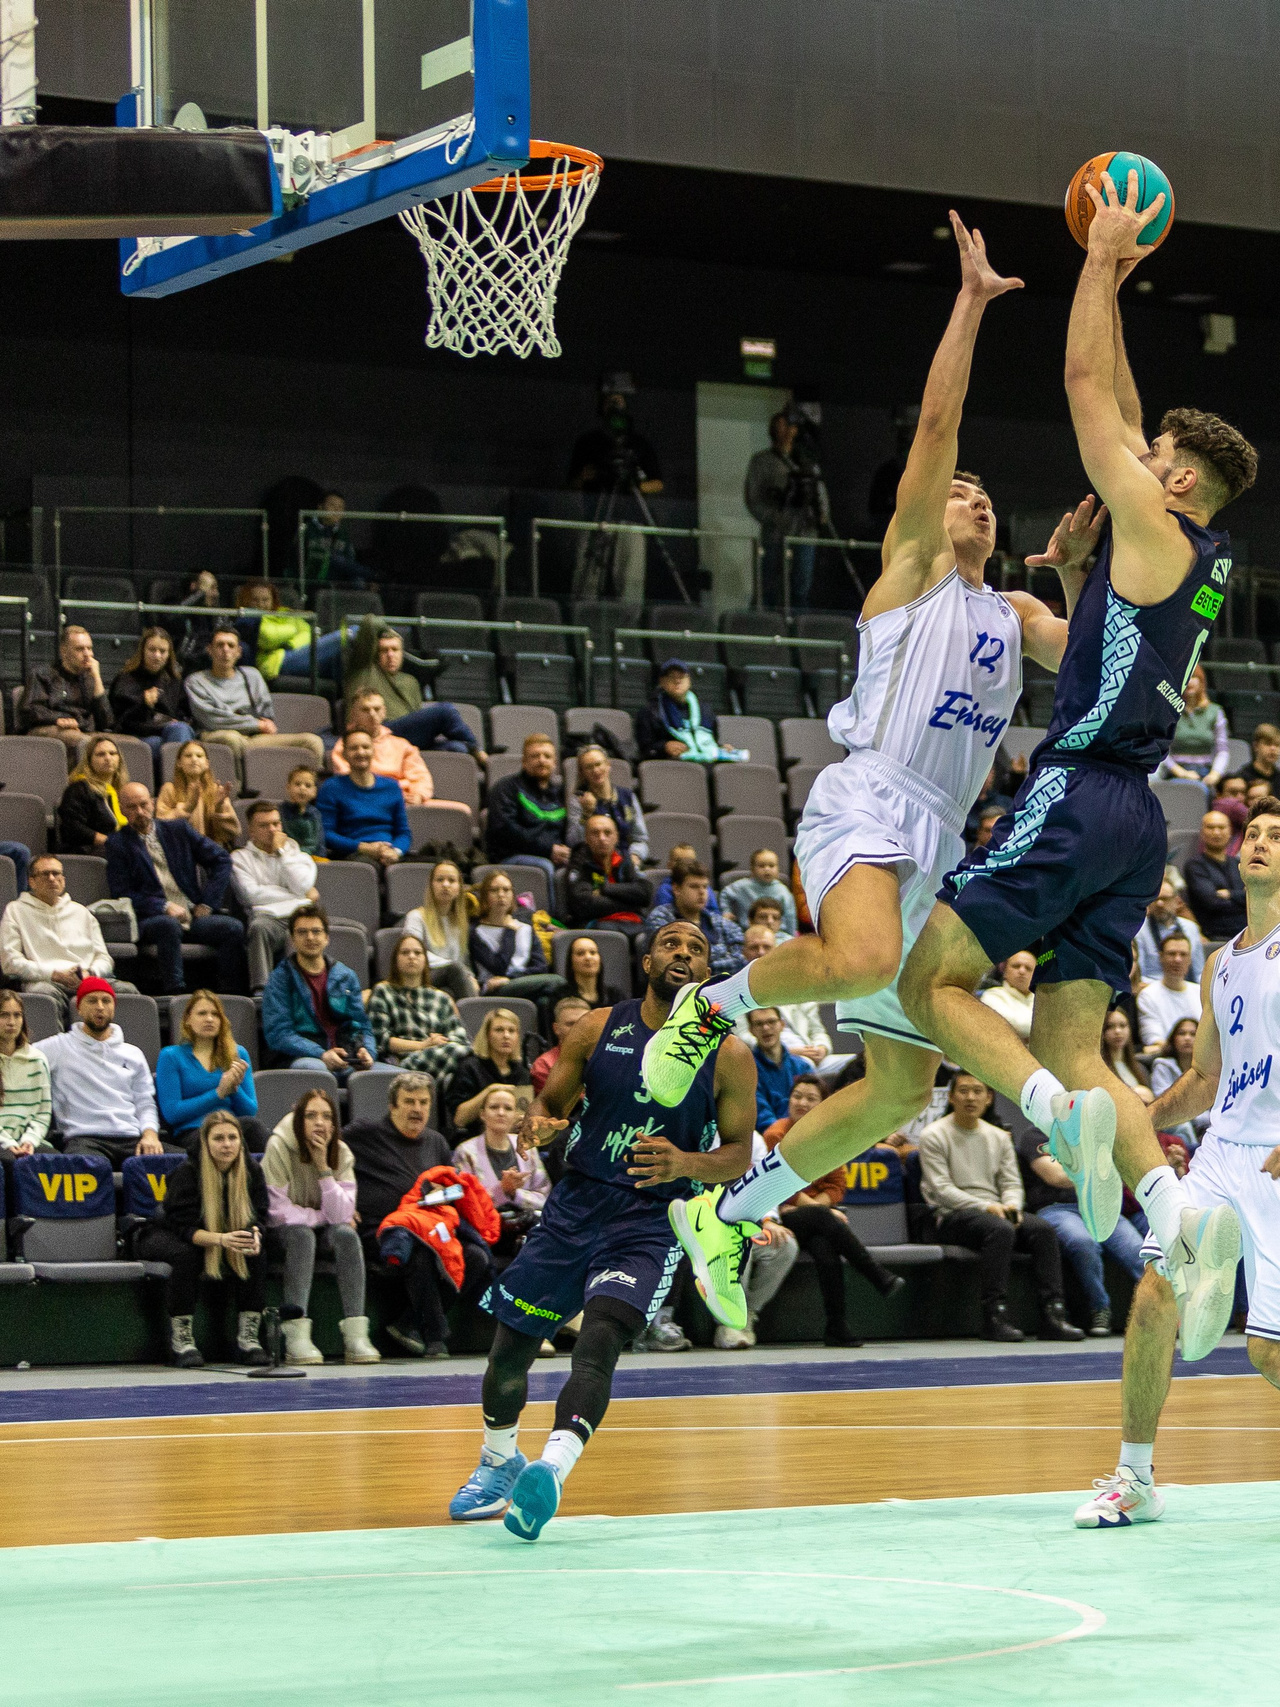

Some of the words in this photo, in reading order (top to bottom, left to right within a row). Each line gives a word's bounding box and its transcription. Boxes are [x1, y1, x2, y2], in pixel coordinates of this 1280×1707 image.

[969, 631, 1005, 673] 12
[1156, 679, 1187, 716] BELTAMO
[928, 690, 1008, 748] Enisey
[1229, 995, 1244, 1037] 2
[605, 1042, 635, 1056] Kempa
[1220, 1054, 1273, 1114] Enisey
[38, 1172, 98, 1202] VIP
[844, 1161, 890, 1190] VIP
[514, 1297, 563, 1322] евроопт
